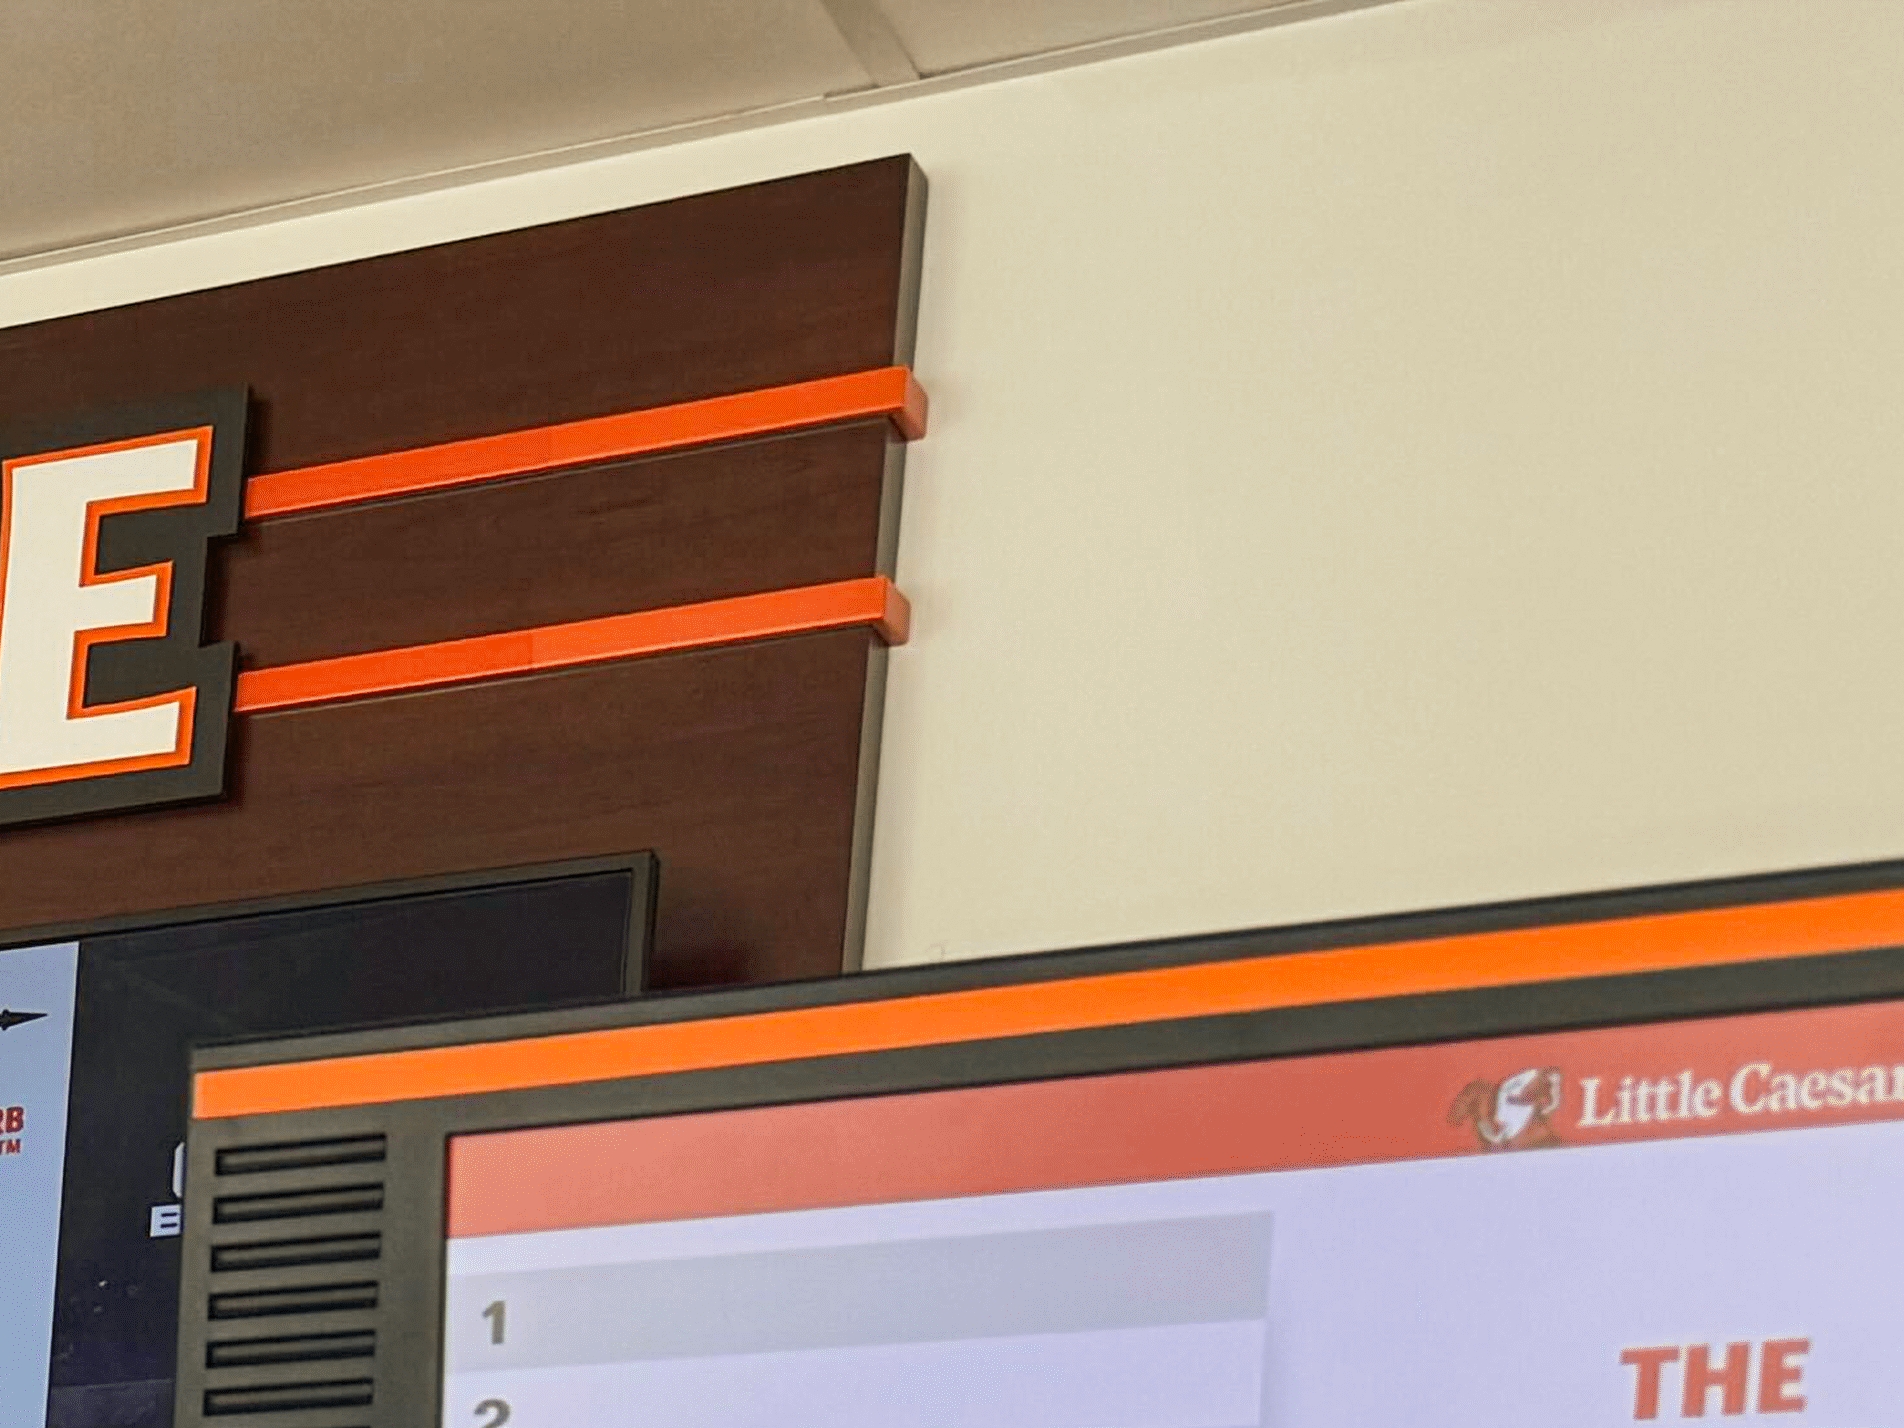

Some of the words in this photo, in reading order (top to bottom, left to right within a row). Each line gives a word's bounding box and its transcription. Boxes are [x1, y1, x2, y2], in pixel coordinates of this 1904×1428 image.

[1576, 1072, 1721, 1128] Little
[481, 1300, 506, 1345] 1
[1620, 1337, 1812, 1422] THE
